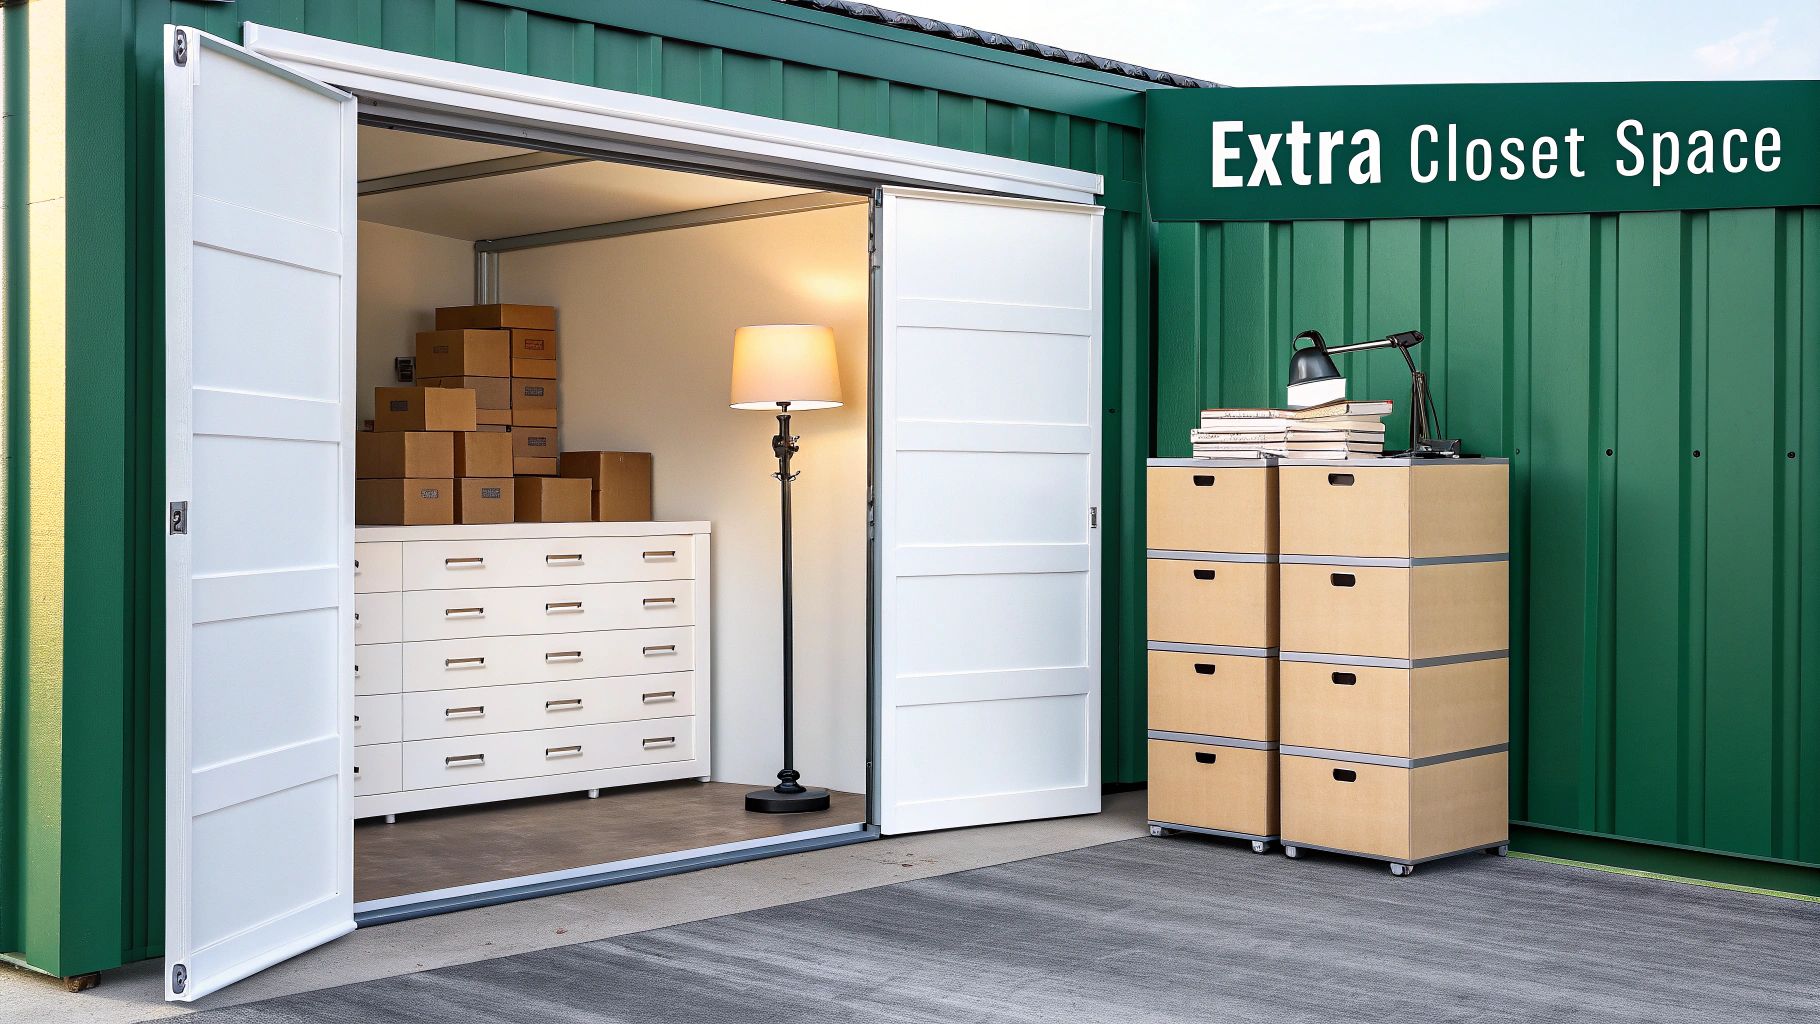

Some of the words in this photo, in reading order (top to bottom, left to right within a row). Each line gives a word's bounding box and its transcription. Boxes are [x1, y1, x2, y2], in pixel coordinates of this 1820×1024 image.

[1212, 120, 1382, 188] Extra
[1410, 123, 1585, 184] Closet
[1616, 119, 1781, 187] Space
